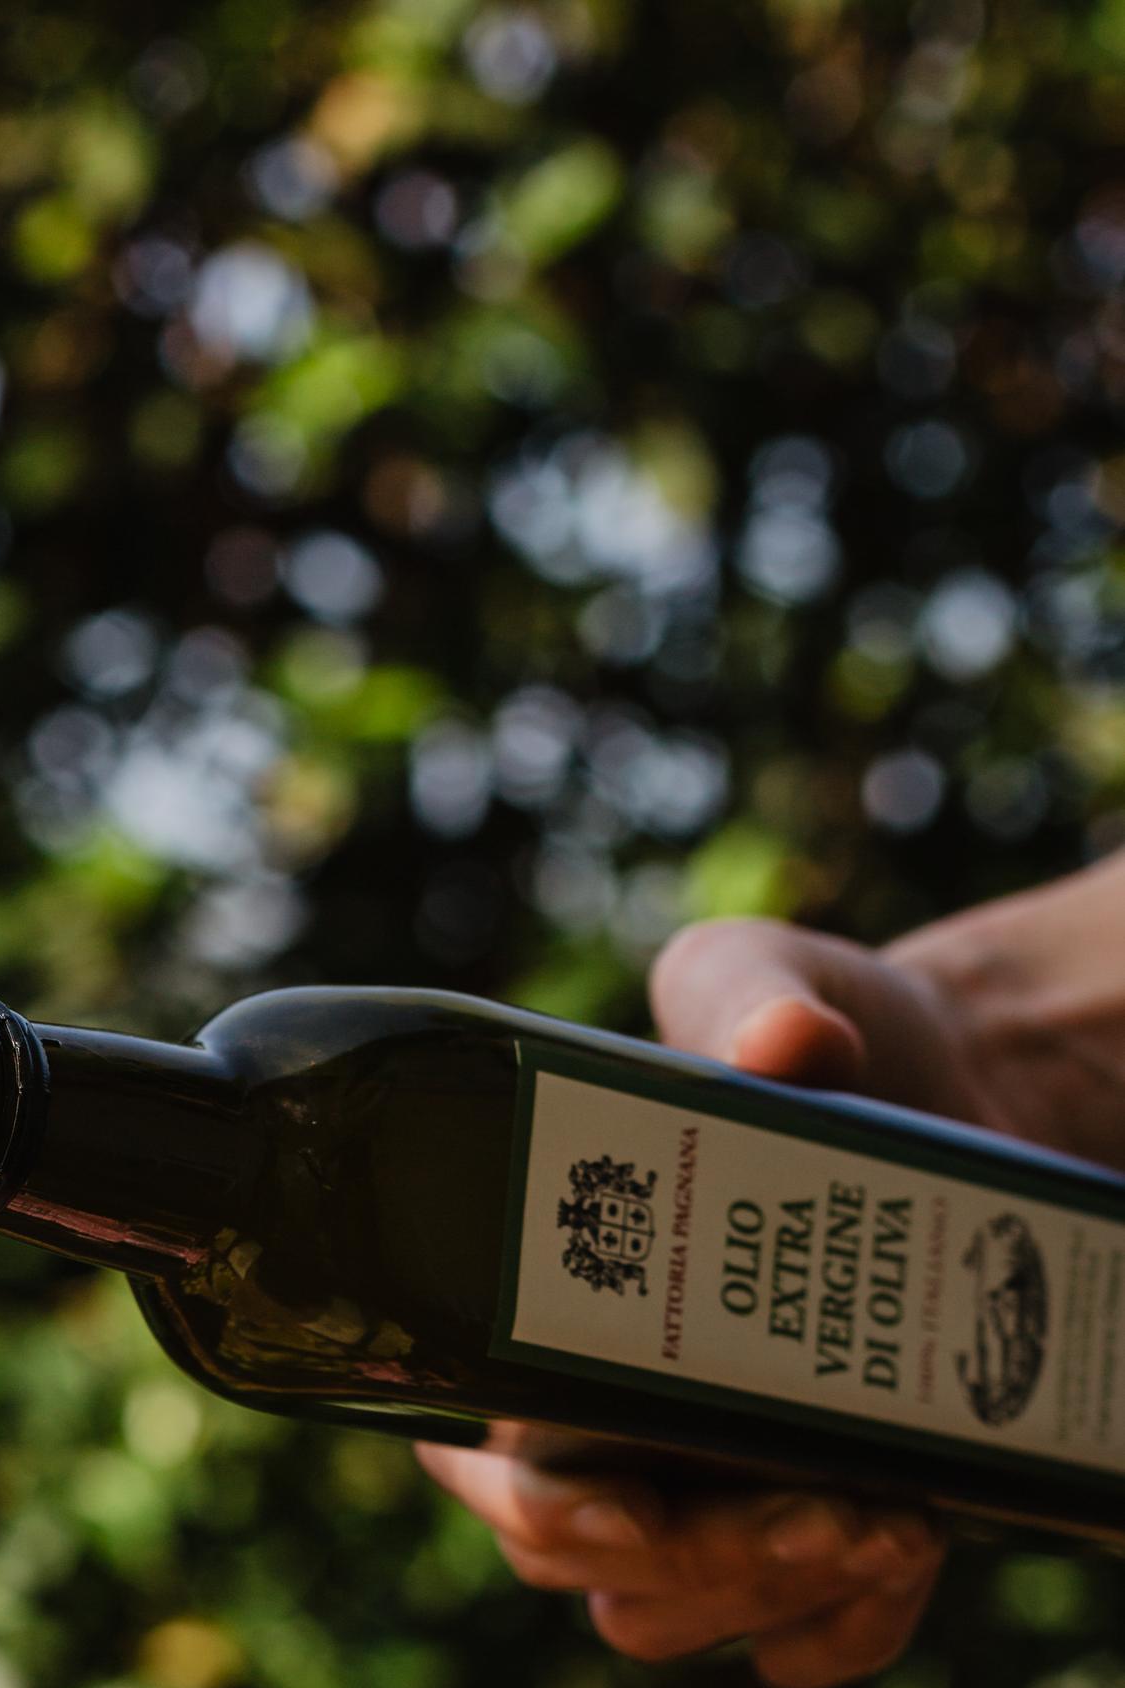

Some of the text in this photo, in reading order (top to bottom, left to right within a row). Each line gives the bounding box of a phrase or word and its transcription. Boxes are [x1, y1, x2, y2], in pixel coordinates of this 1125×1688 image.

[661, 1127, 699, 1361] FATTORIA PAGNANA
[720, 1199, 765, 1317] OLIO
[769, 1198, 817, 1343] EXTRA
[815, 1180, 866, 1377] VERGINE
[863, 1197, 912, 1392] DI OLIVA
